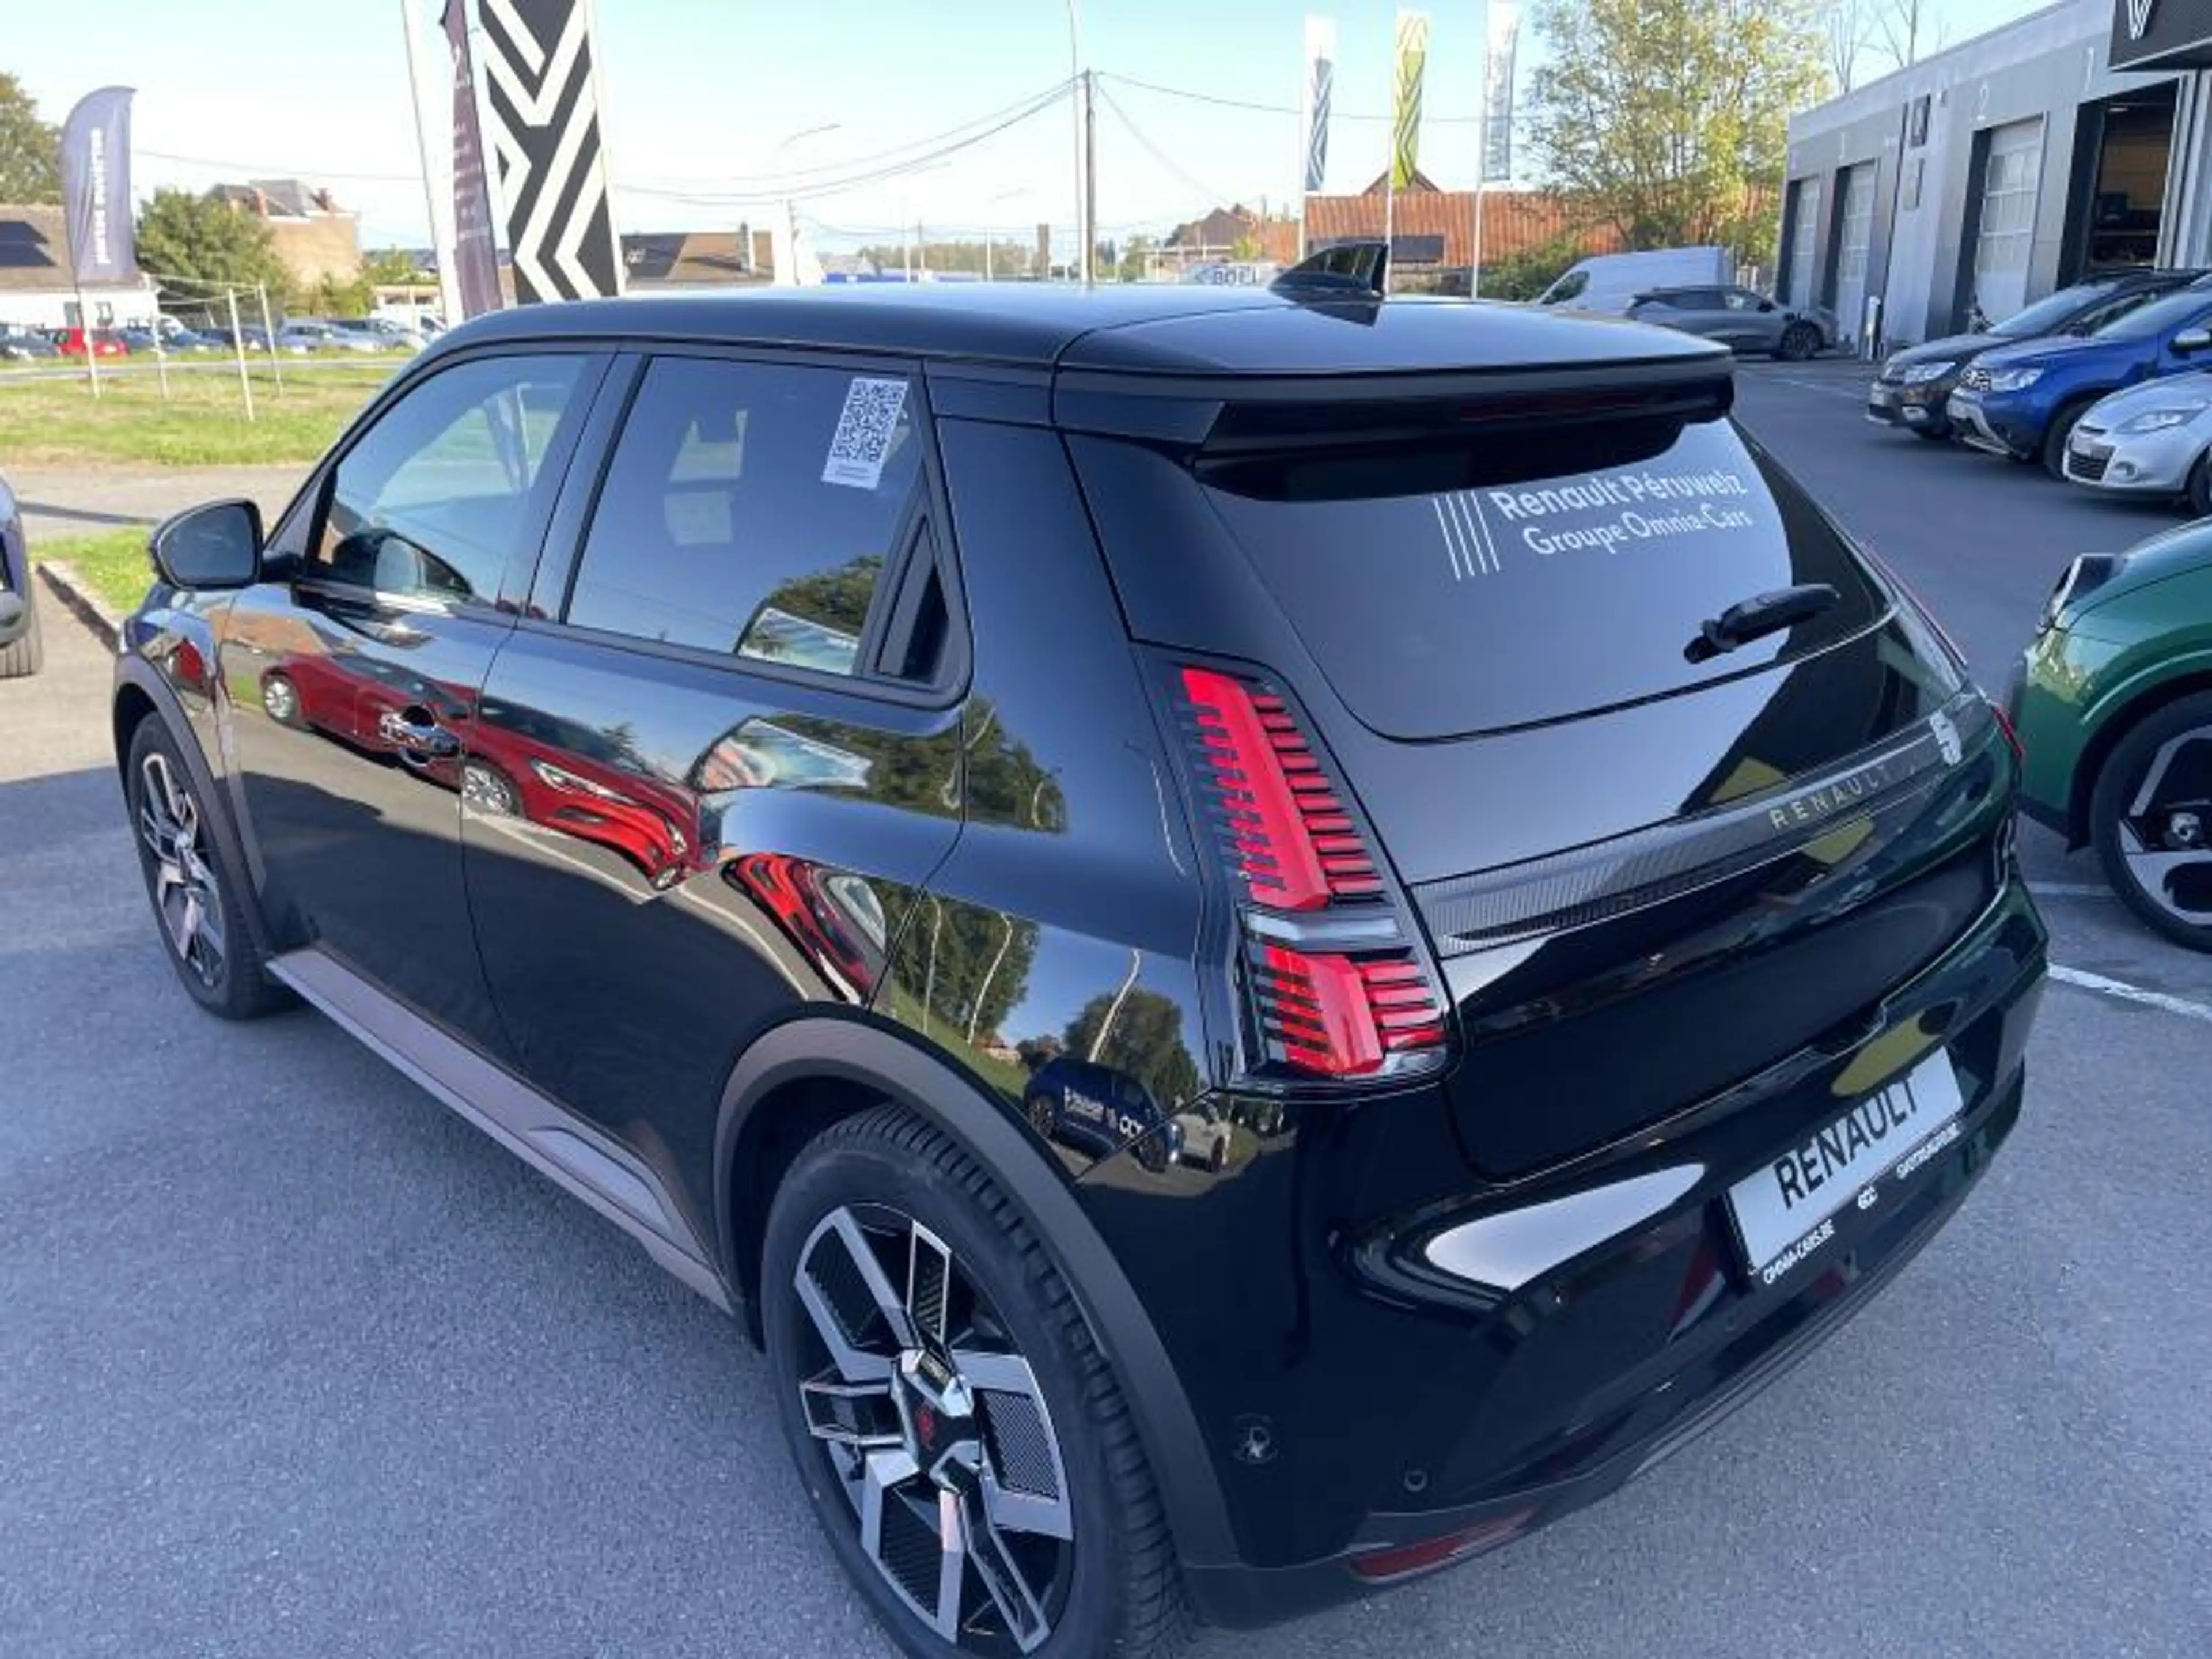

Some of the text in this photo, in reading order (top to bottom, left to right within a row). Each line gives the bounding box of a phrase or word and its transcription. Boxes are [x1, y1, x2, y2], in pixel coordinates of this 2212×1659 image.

[1488, 477, 1631, 520] Renault
[1522, 522, 1630, 555] Groupe
[1768, 763, 1891, 830] RENAULT
[1772, 1075, 1917, 1210] RENAULT
